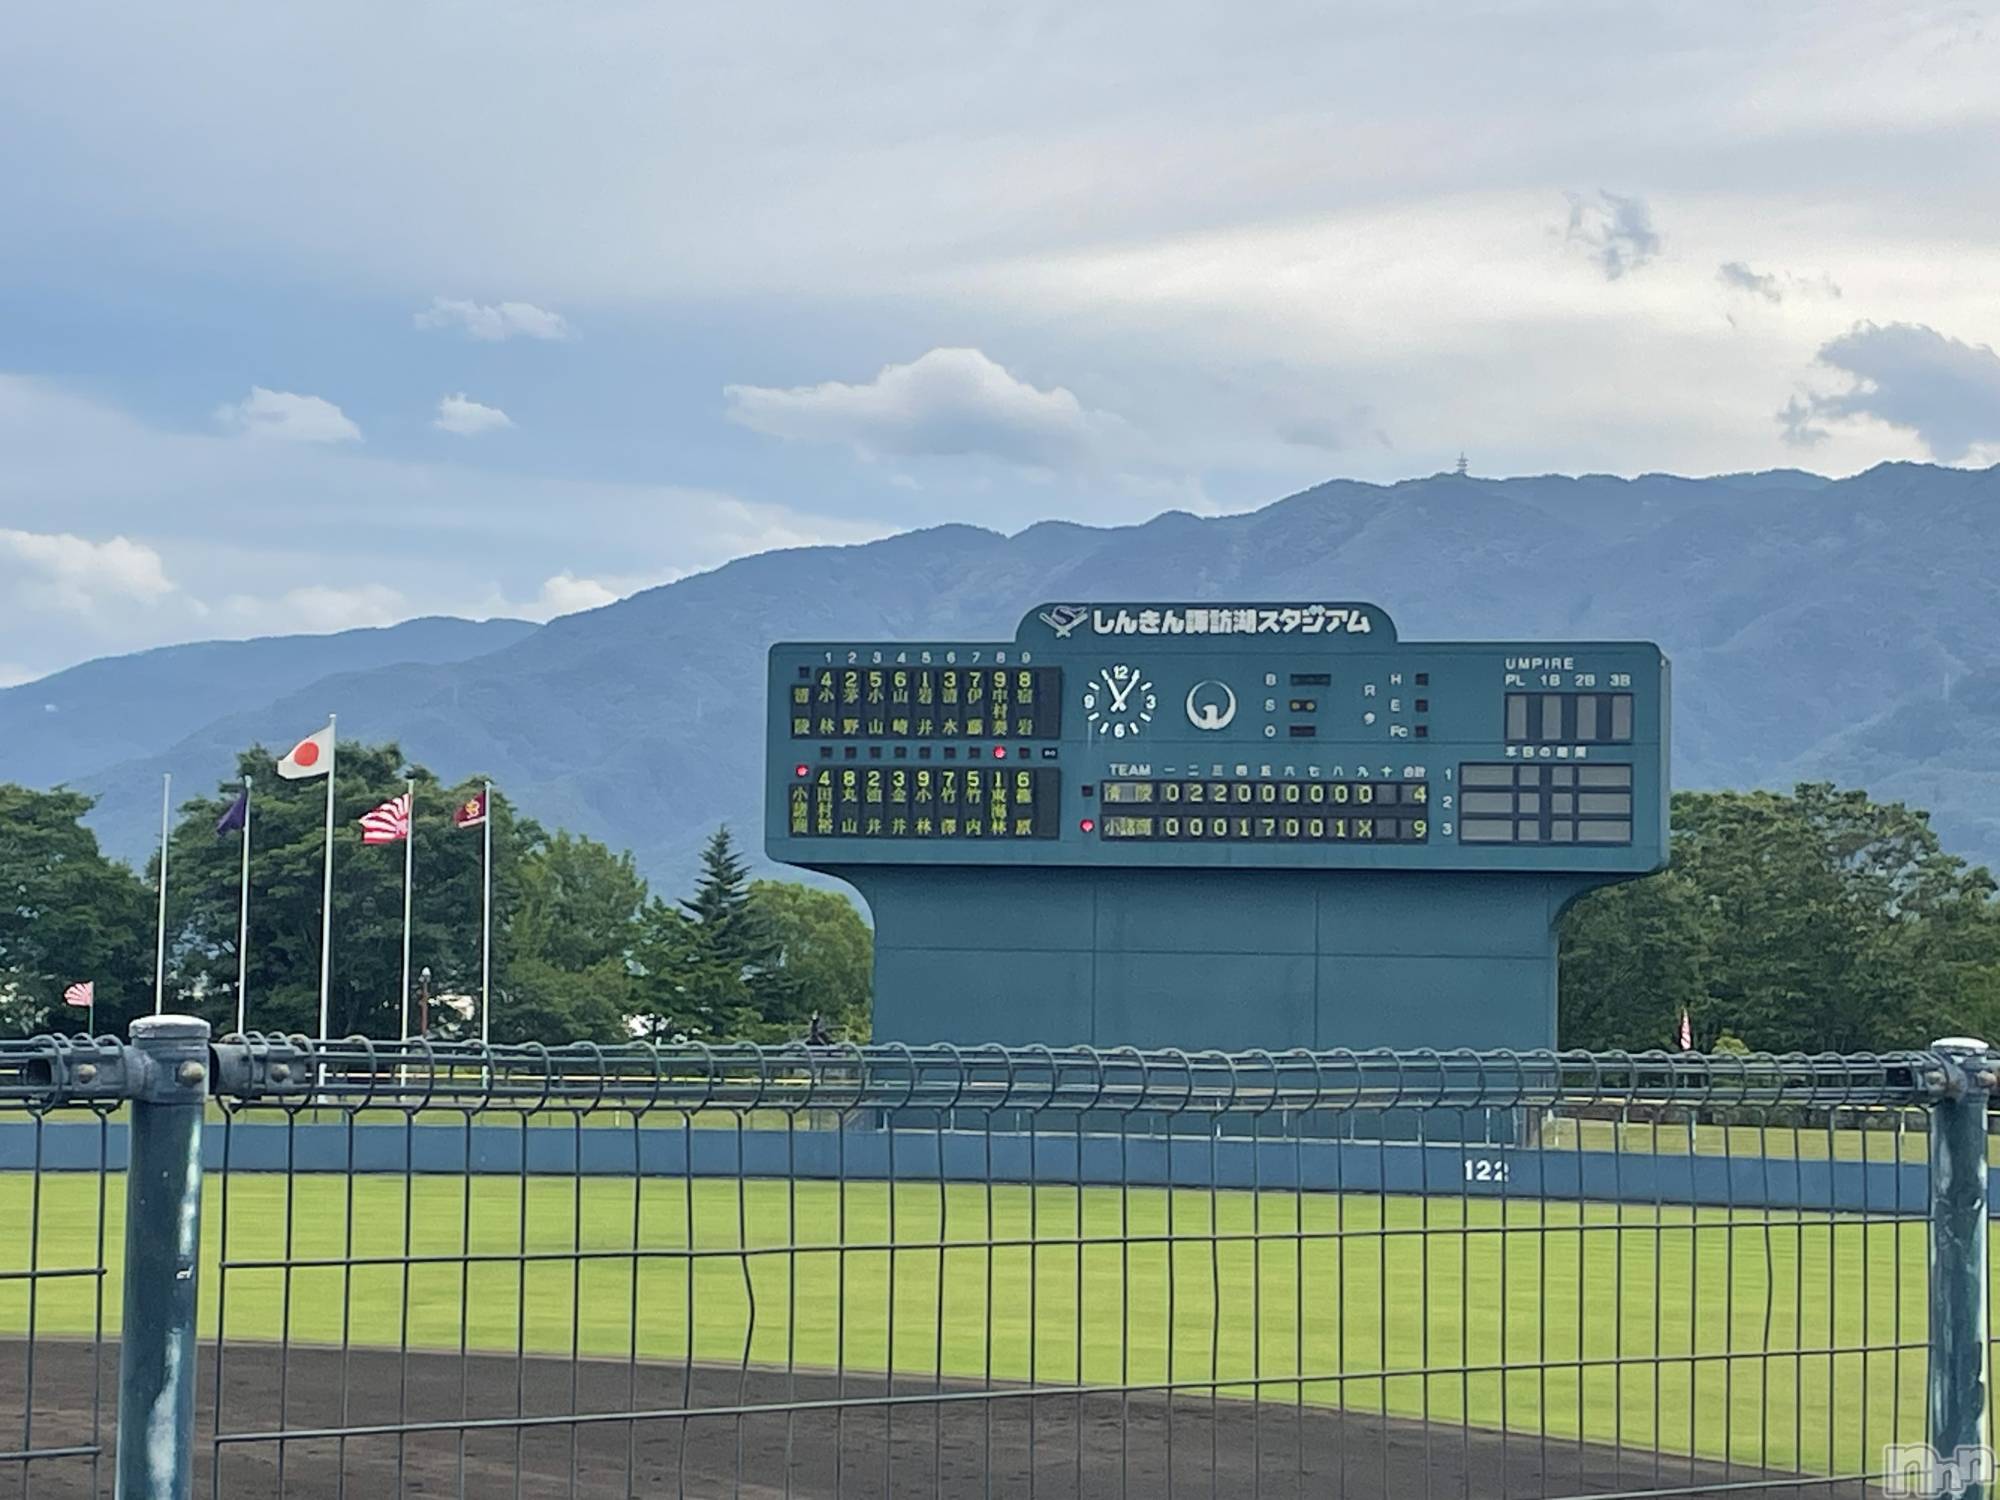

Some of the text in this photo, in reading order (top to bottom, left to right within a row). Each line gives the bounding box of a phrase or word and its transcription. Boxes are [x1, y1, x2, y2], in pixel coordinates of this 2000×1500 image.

[826, 652, 1030, 663] 1 2 3 4 5 6 7 8 9
[1506, 657, 1573, 669] UMPIRE
[1114, 665, 1128, 679] 12
[821, 672, 1030, 689] 4 2 5 6 1 3 7 9 8
[1391, 674, 1401, 685] H
[1506, 674, 1630, 686] PL 1B 2B 3B
[1146, 694, 1156, 709] 3
[1265, 699, 1275, 711] S
[1391, 699, 1400, 712] E
[868, 688, 883, 735] 小山
[1114, 723, 1125, 738] 6
[1110, 764, 1150, 776] TEAM
[1446, 769, 1451, 779] 1
[819, 771, 1029, 788] 4 8 2 3 9 7 5 1 6
[1165, 784, 1179, 801] 0
[1188, 784, 1203, 801] 2
[1213, 784, 1227, 801] 2
[1236, 785, 1251, 802] 0
[1263, 785, 1275, 802] 0
[1284, 785, 1299, 802] 0
[1311, 785, 1323, 802] 0
[1335, 785, 1348, 802] 0
[1357, 785, 1372, 803] 0
[1414, 786, 1426, 803] 4
[1443, 796, 1452, 808] 2
[1166, 819, 1178, 835] 0
[1190, 819, 1202, 835] 0
[1214, 819, 1226, 835] 0
[1240, 819, 1248, 836] 1
[1262, 819, 1274, 836] 7
[1286, 819, 1298, 836] 0
[1310, 819, 1323, 836] 0
[1337, 820, 1345, 837] 1
[1414, 820, 1426, 837] 9
[1443, 823, 1452, 834] 3
